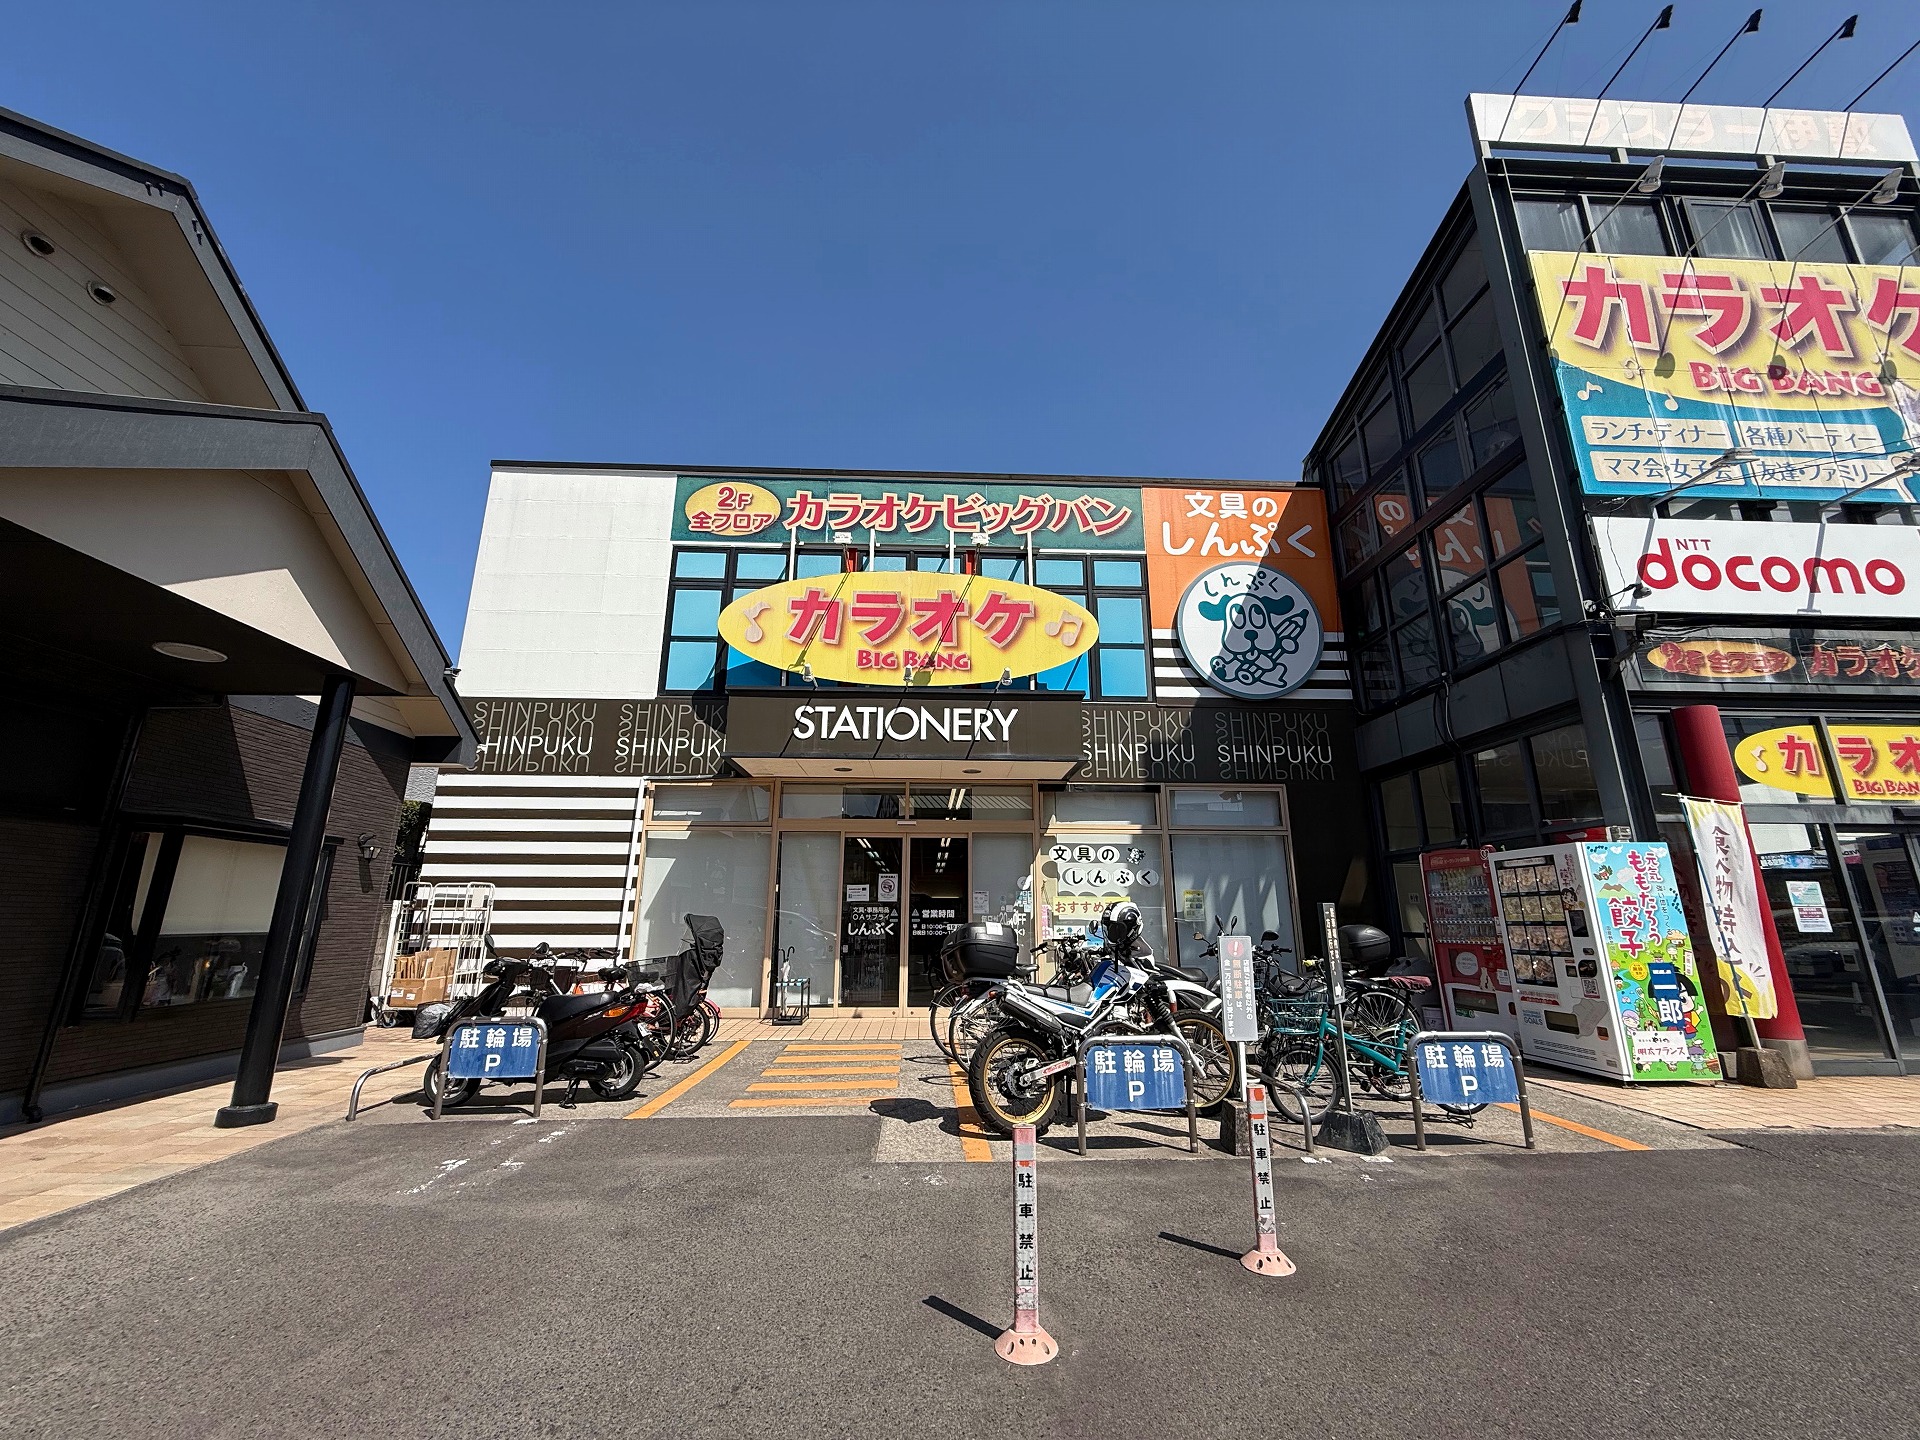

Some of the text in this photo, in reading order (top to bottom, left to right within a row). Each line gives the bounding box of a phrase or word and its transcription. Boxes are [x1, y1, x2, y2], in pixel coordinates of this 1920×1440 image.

[1688, 361, 1886, 397] BIG BANG
[1591, 421, 1726, 444] ランチ・ディナー
[1745, 425, 1878, 448] 各種パーティー
[718, 486, 749, 509] 2F
[1184, 491, 1278, 519] 文具の
[689, 510, 776, 532] 全フロア
[783, 490, 1131, 535] カラオケビッグバン
[1162, 521, 1316, 558] しんぷく
[1675, 538, 1711, 551] NTT
[1637, 538, 1906, 595] docomo
[1204, 570, 1279, 597] しんぷく
[785, 589, 1035, 647] カラオケ
[856, 650, 970, 671] BIG BANG
[793, 705, 1018, 742] STATIONERY
[477, 735, 593, 755] HINPUKU
[616, 737, 727, 757] SHINPUK
[1218, 744, 1332, 763] SHINPUKU
[1853, 779, 1883, 794] BIG
[1053, 846, 1114, 861] 文具の
[1072, 870, 1152, 885] しんぷく
[1645, 852, 1662, 881] 元気
[1628, 851, 1662, 945] ももたろう
[1711, 825, 1743, 966] 食べ物持込
[922, 909, 955, 918] 営業時間
[1055, 901, 1112, 914] おすすめ
[848, 922, 895, 936] しんぷく
[1608, 896, 1644, 958] 餃子
[1233, 959, 1243, 1011] 無断駐車は、
[1223, 959, 1236, 1038] 金一万円を申し受けます。
[459, 1027, 533, 1049] 駐輪場
[1094, 1049, 1175, 1075] 駐輪場
[1424, 1044, 1505, 1069] 駐輪場
[1637, 1046, 1687, 1056] 明太フランス
[484, 1054, 501, 1073] P
[1129, 1081, 1145, 1102] P
[1462, 1075, 1479, 1097] P
[1254, 1123, 1272, 1210] 駐車禁止
[1018, 1172, 1034, 1282] 駐車禁止
